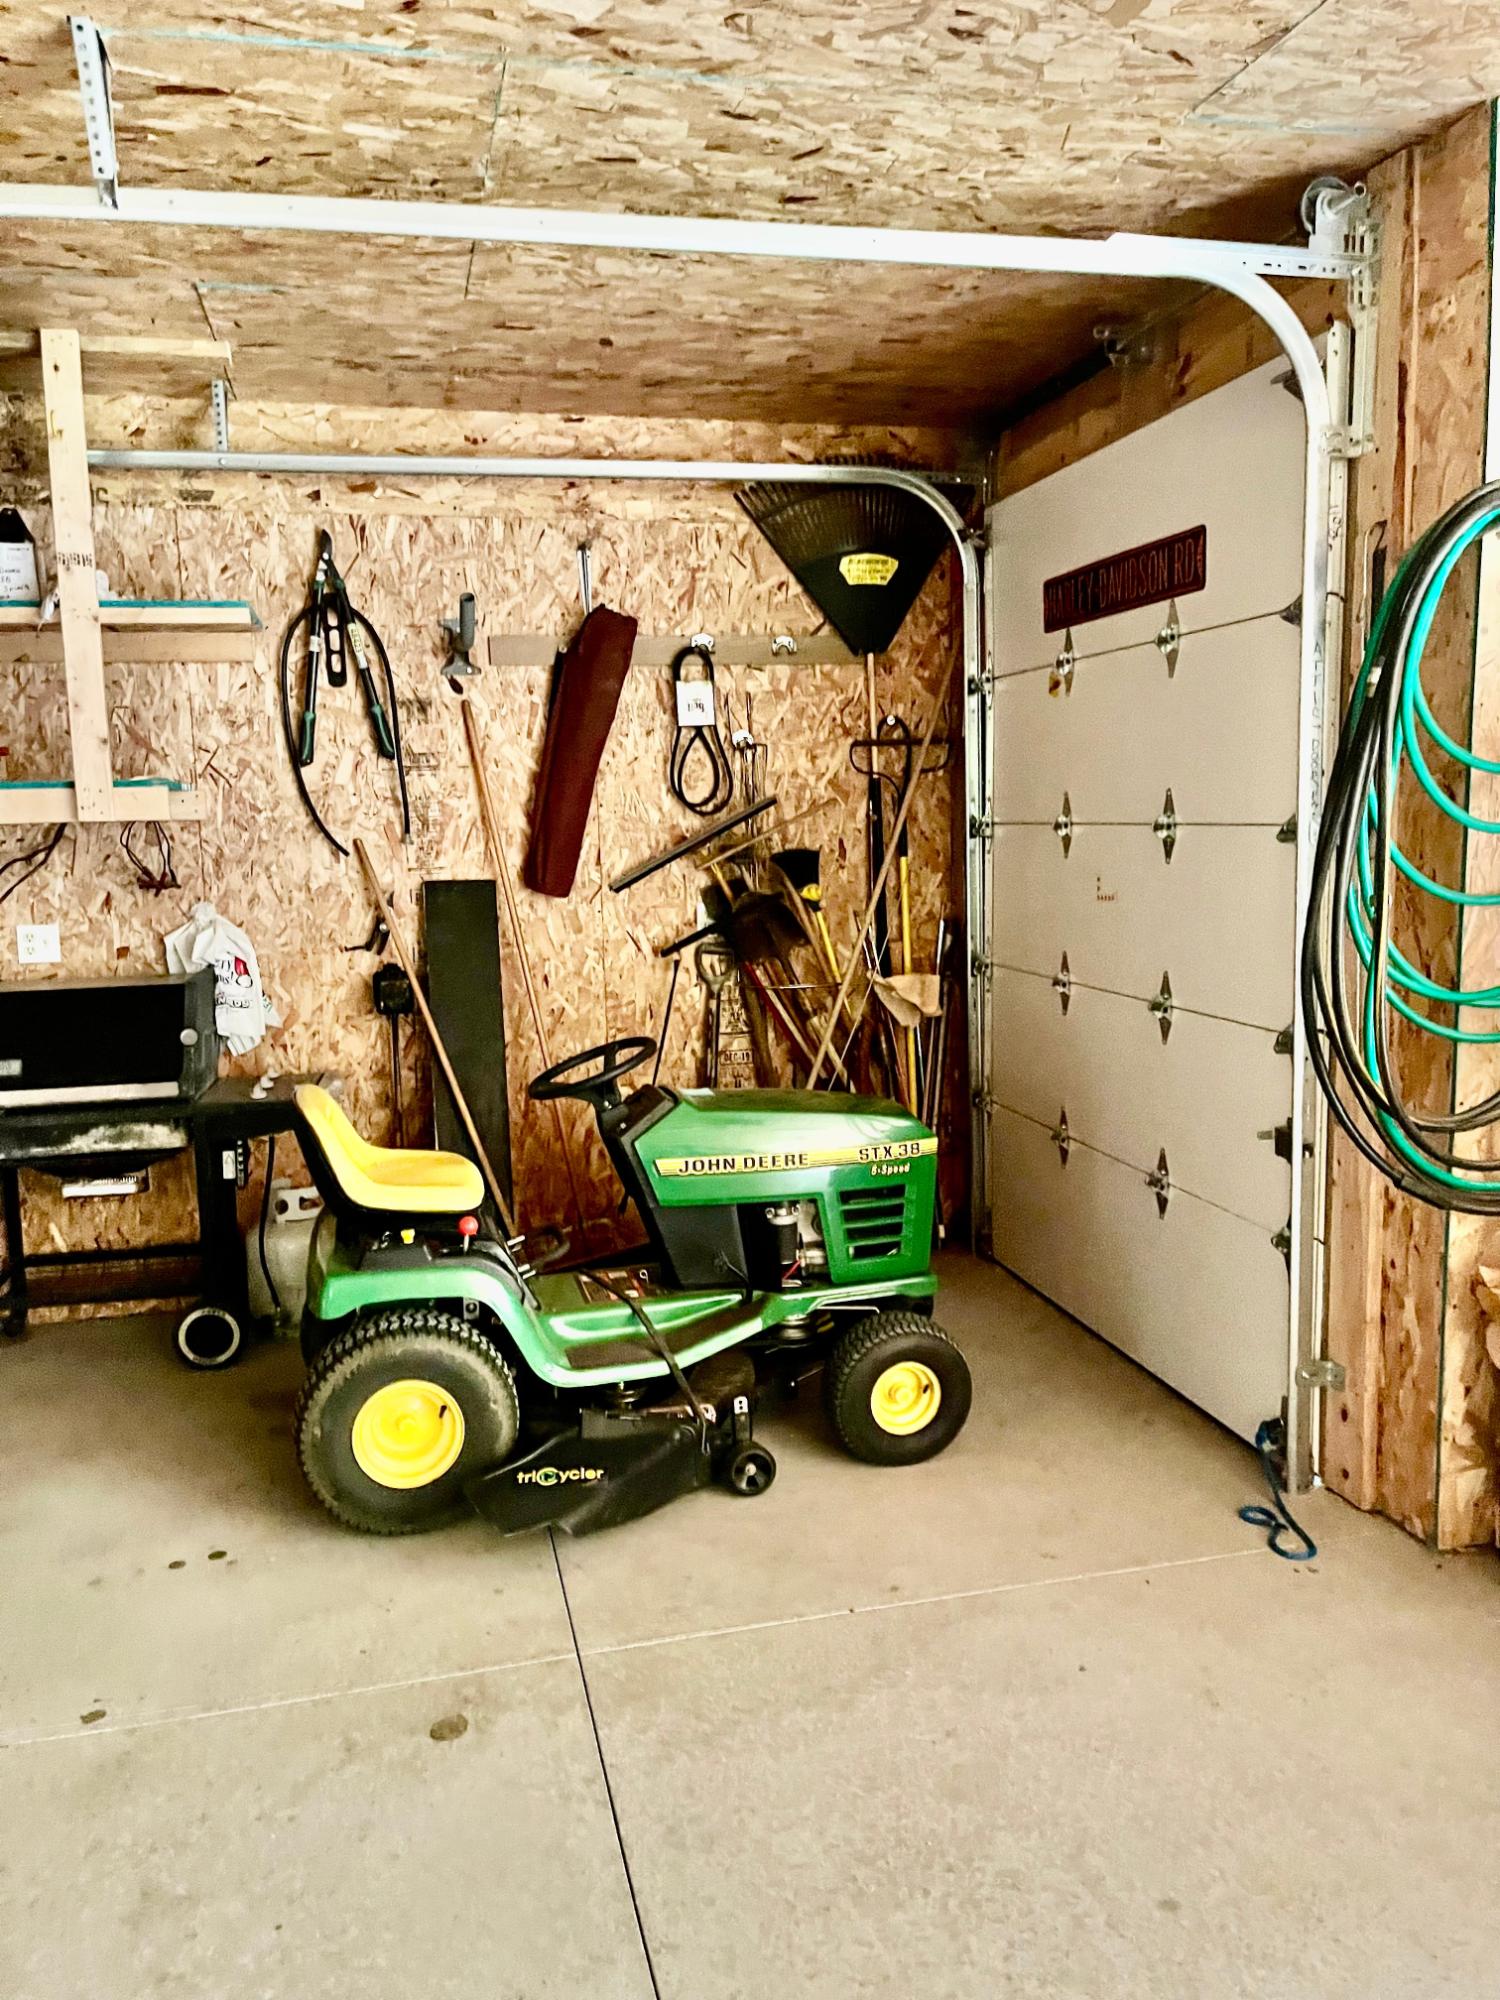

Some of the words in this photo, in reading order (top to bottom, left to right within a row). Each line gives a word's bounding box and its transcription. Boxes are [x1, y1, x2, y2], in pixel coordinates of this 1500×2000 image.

[1174, 538, 1195, 585] RD
[859, 1146, 892, 1160] STX
[899, 1143, 920, 1156] 38
[679, 1158, 735, 1173] JOHN
[743, 1153, 808, 1169] DEERE
